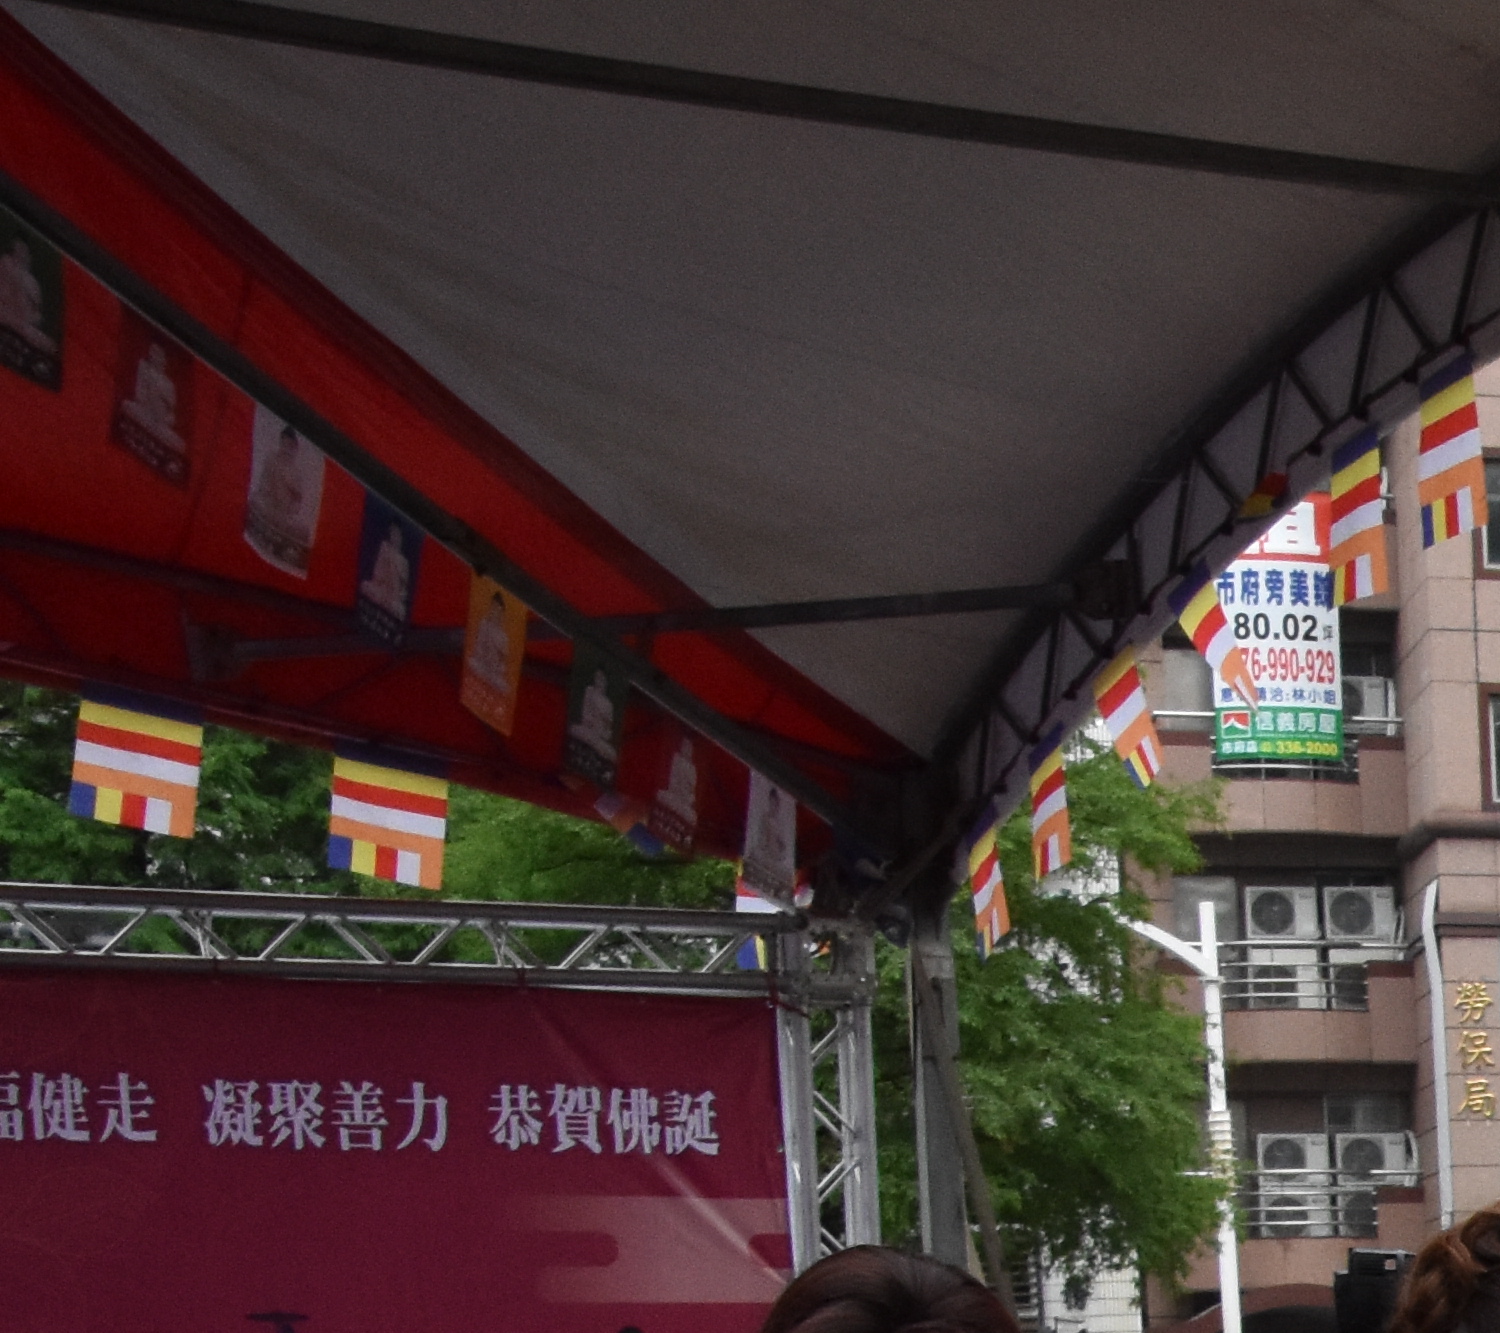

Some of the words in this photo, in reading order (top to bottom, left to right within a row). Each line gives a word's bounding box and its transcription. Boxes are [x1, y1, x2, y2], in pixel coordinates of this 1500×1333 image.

[1234, 612, 1319, 642] 80.02
[1240, 646, 1335, 684] 76-990-929
[1454, 982, 1496, 1118] 勞保局
[200, 1078, 451, 1153] 凝聚善力
[487, 1082, 723, 1156] 恭賀佛誕
